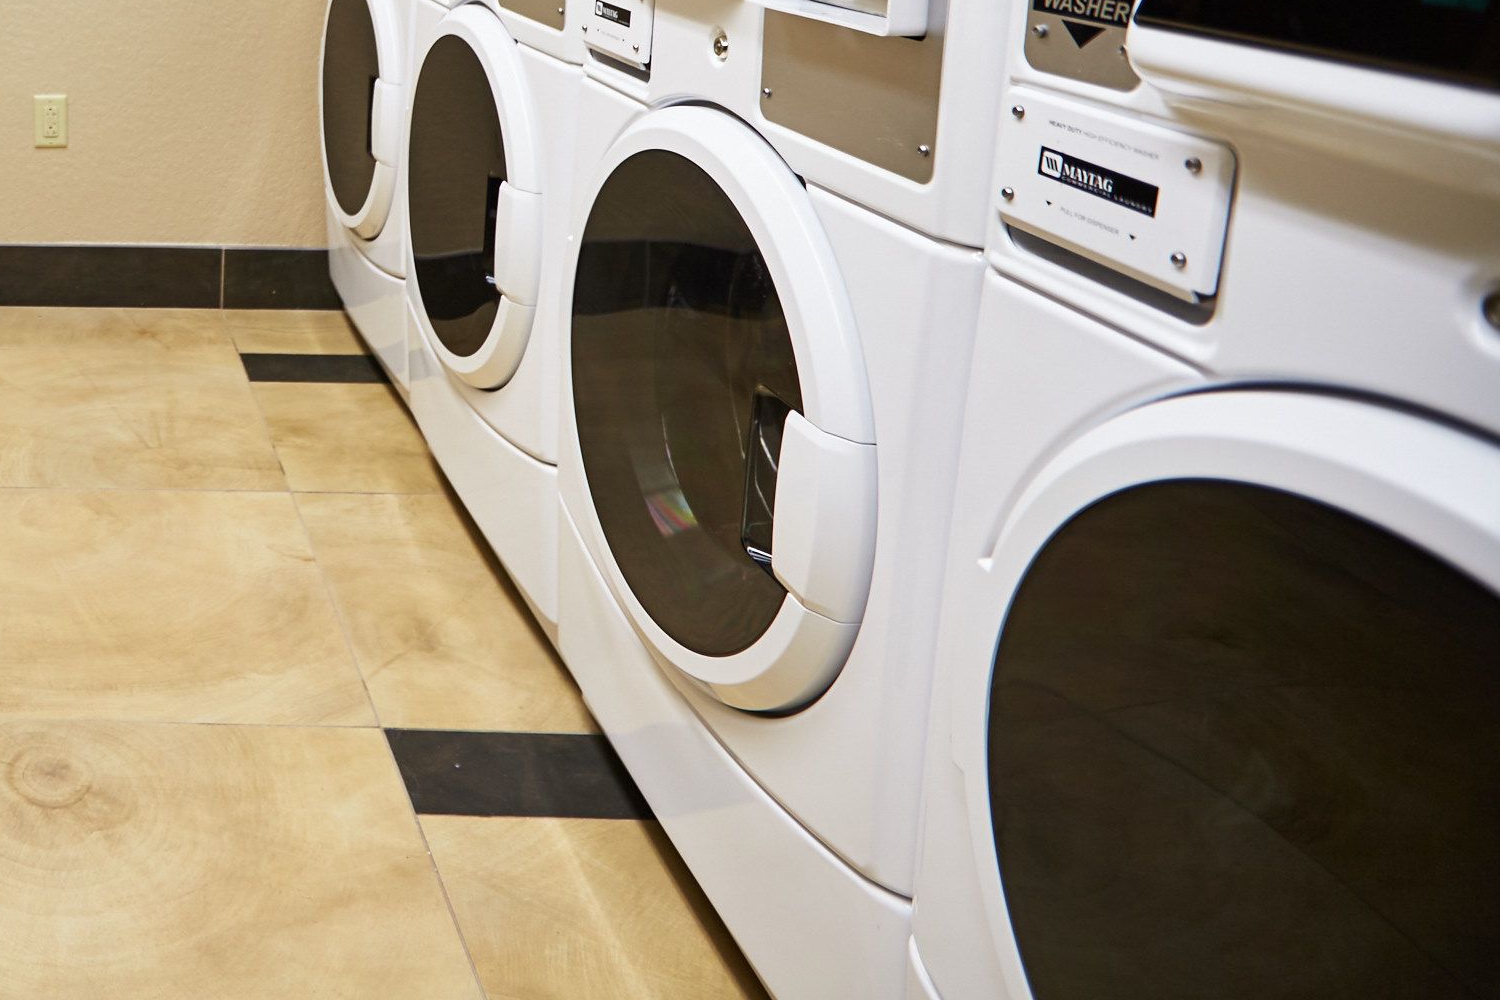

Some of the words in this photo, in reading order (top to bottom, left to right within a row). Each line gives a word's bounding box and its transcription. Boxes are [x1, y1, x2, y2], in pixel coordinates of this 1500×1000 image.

[1049, 119, 1067, 130] HEAVY
[1067, 124, 1082, 134] DUTY
[1062, 163, 1114, 193] MAYTAG
[1061, 175, 1112, 199] COMMERCIAL
[1113, 193, 1153, 214] LAUNDRY
